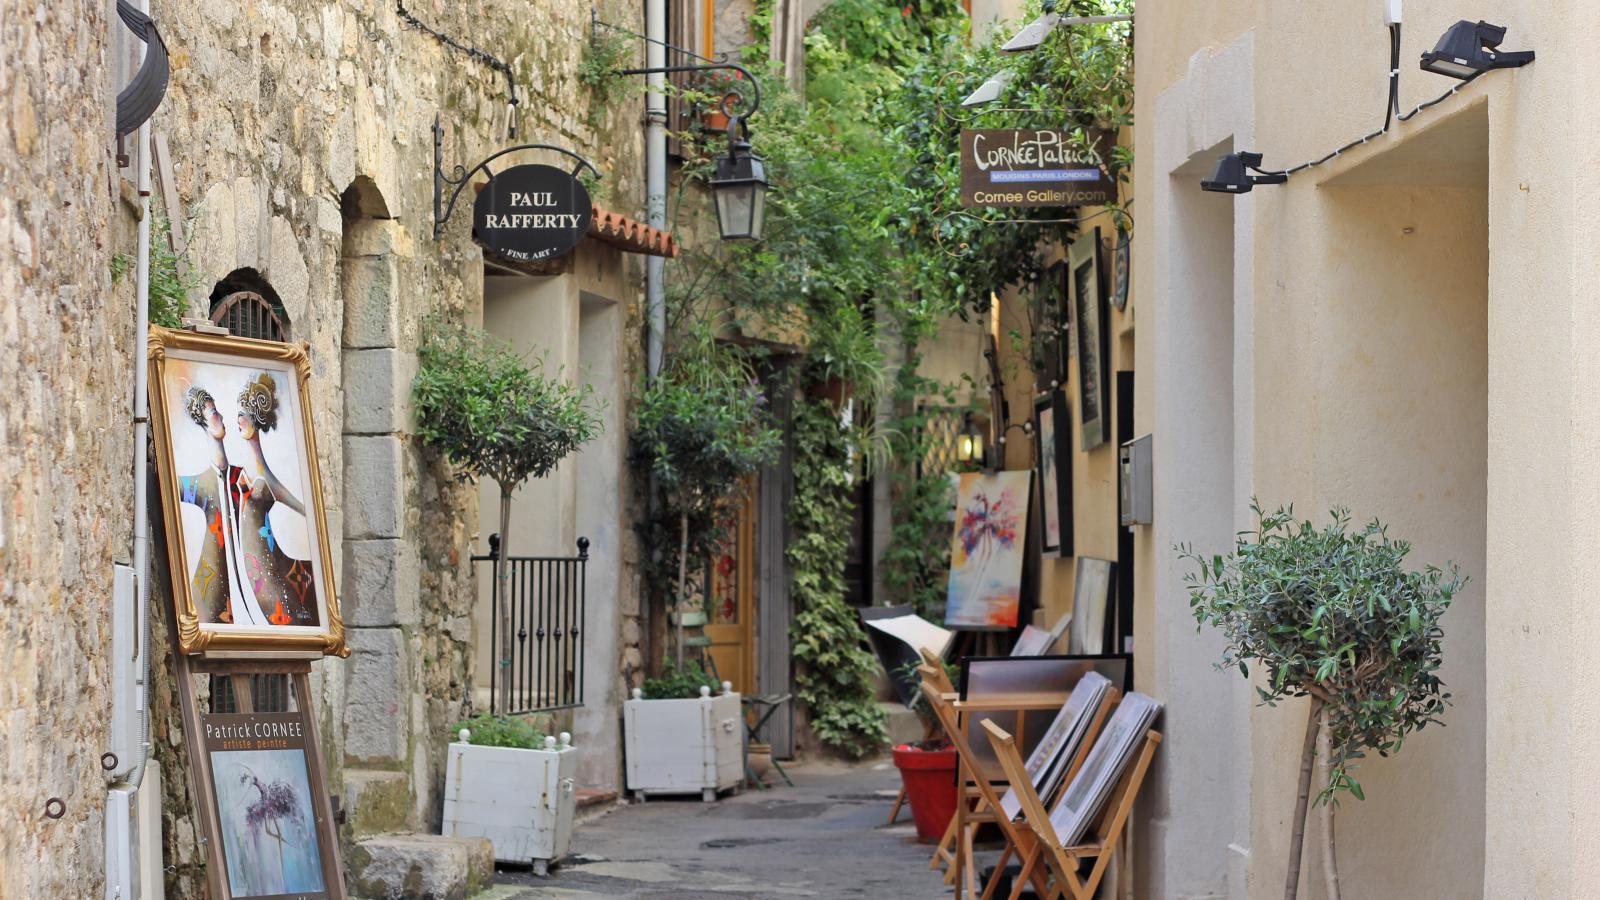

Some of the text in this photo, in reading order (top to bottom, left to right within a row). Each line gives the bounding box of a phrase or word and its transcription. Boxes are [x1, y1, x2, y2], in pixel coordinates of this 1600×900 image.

[510, 192, 557, 207] PAUL
[974, 189, 1106, 203] Cornee Gallery.com
[485, 214, 581, 228] RAFFERTY
[506, 248, 551, 260] FINE ART
[206, 722, 302, 738] Patrick CORNEE
[223, 739, 288, 750] artiste peintre
